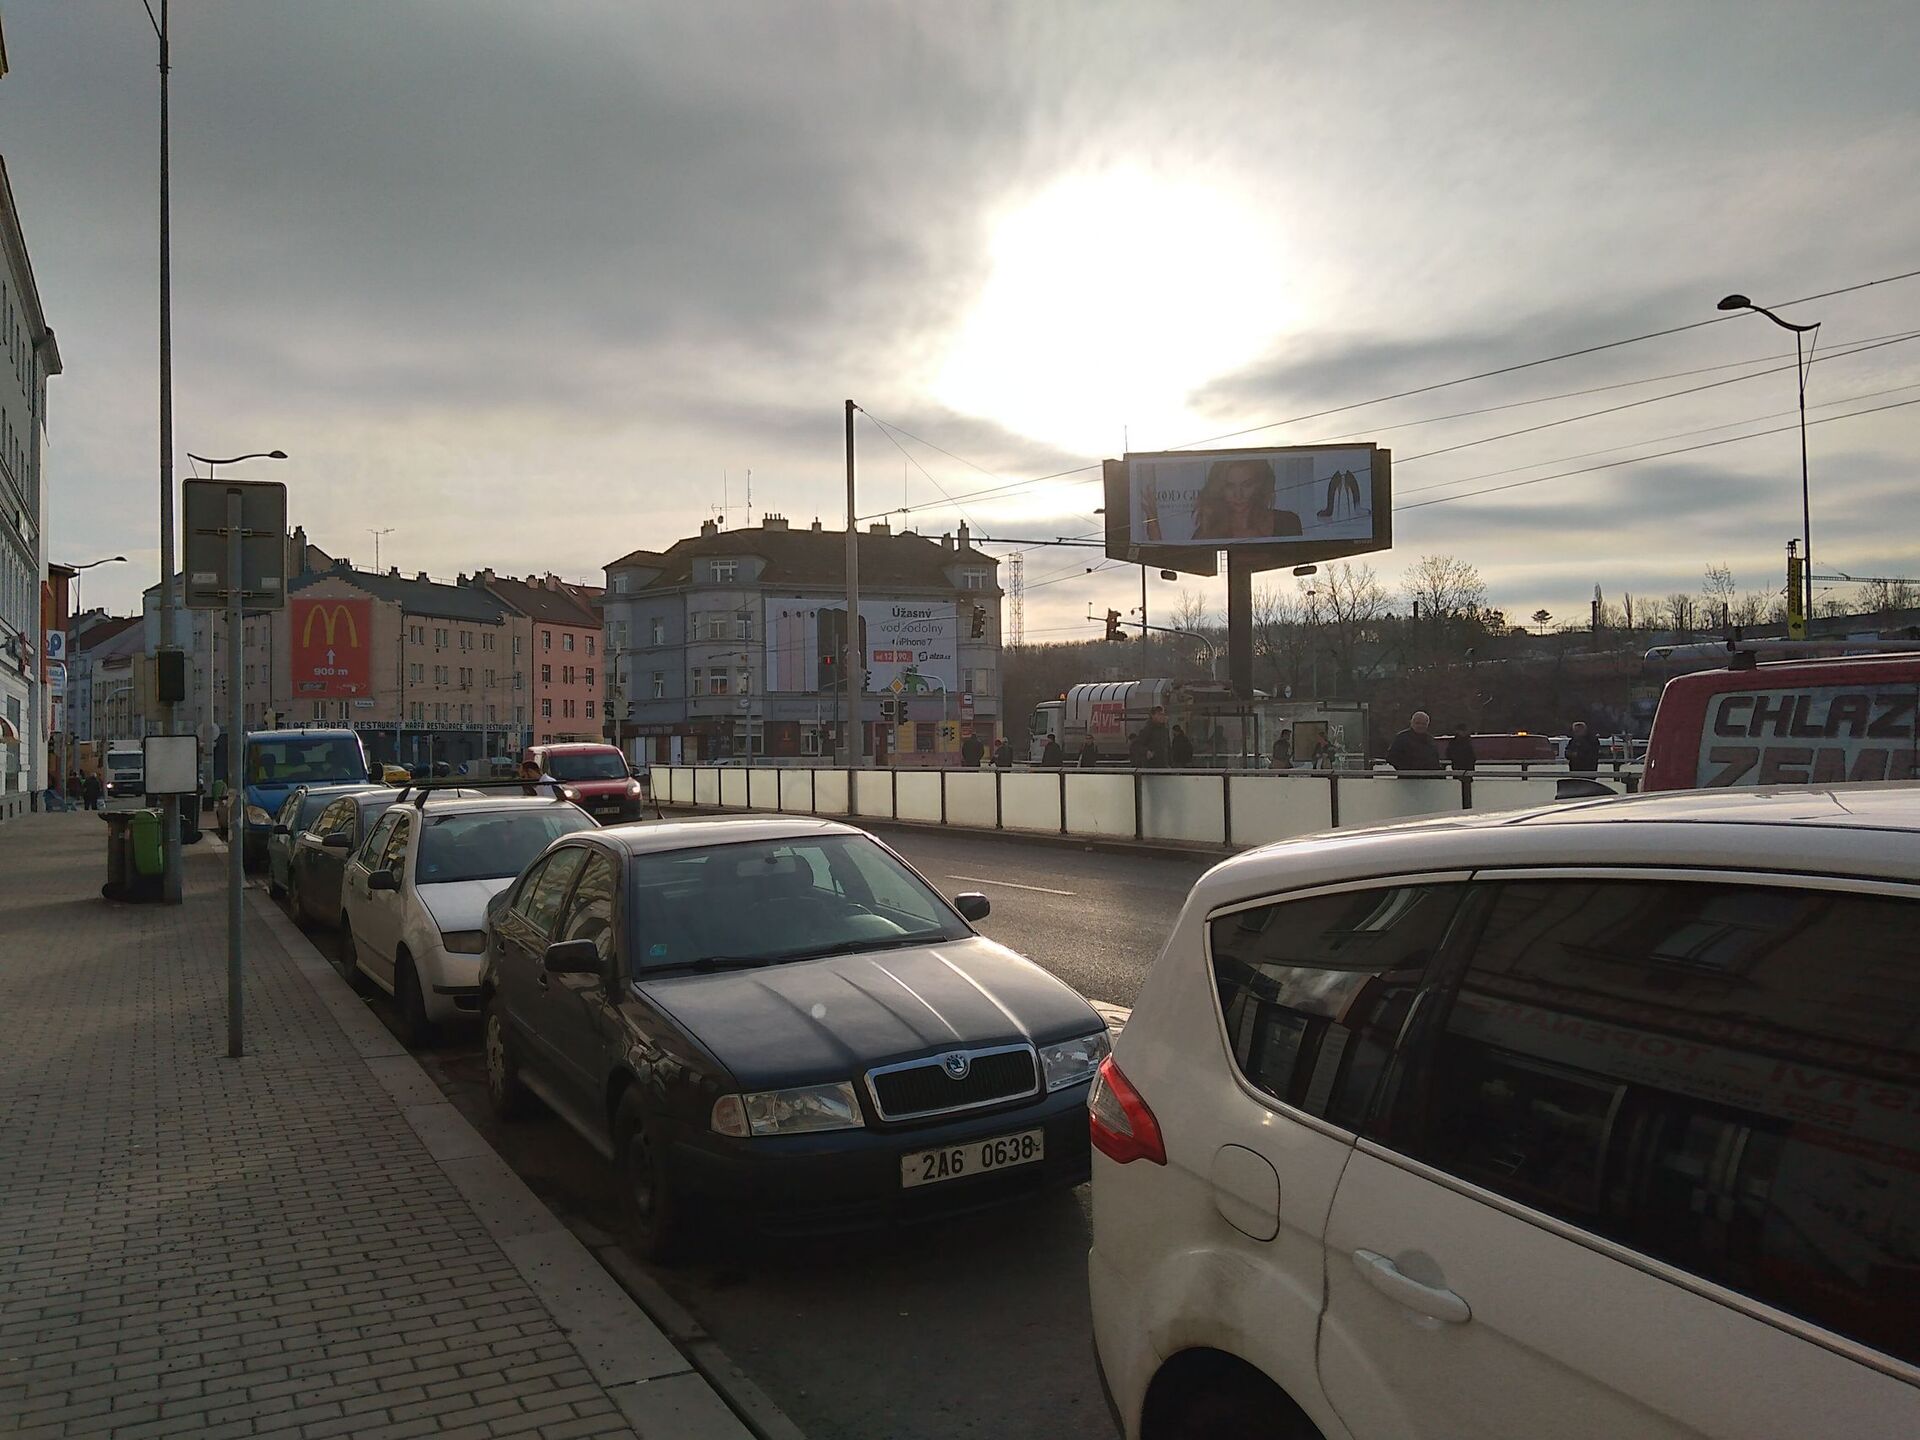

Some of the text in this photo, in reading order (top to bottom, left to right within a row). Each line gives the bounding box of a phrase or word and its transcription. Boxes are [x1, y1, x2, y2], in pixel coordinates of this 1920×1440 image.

[892, 605, 932, 618] Úžasný
[313, 667, 349, 676] 900 m
[922, 1135, 1034, 1181] 2A6 0638
